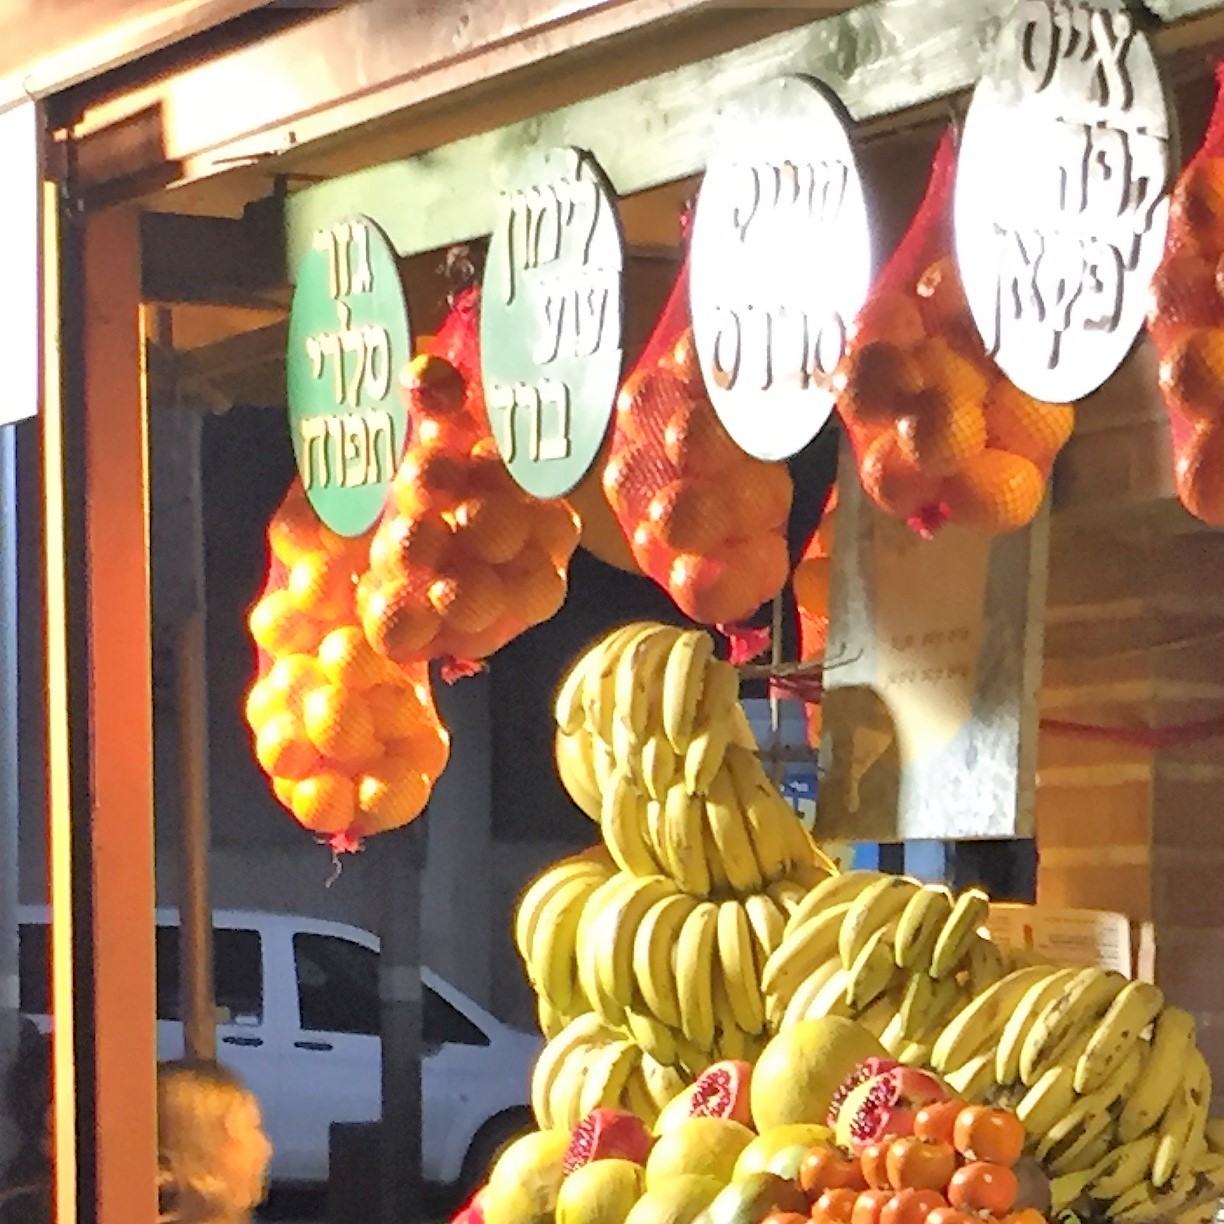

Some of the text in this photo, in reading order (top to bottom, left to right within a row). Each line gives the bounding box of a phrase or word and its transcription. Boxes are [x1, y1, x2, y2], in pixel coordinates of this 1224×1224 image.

[313, 217, 374, 301] גזר
[497, 147, 600, 305] לימון
[306, 301, 393, 407] סלרי
[300, 409, 397, 490] תפוח
